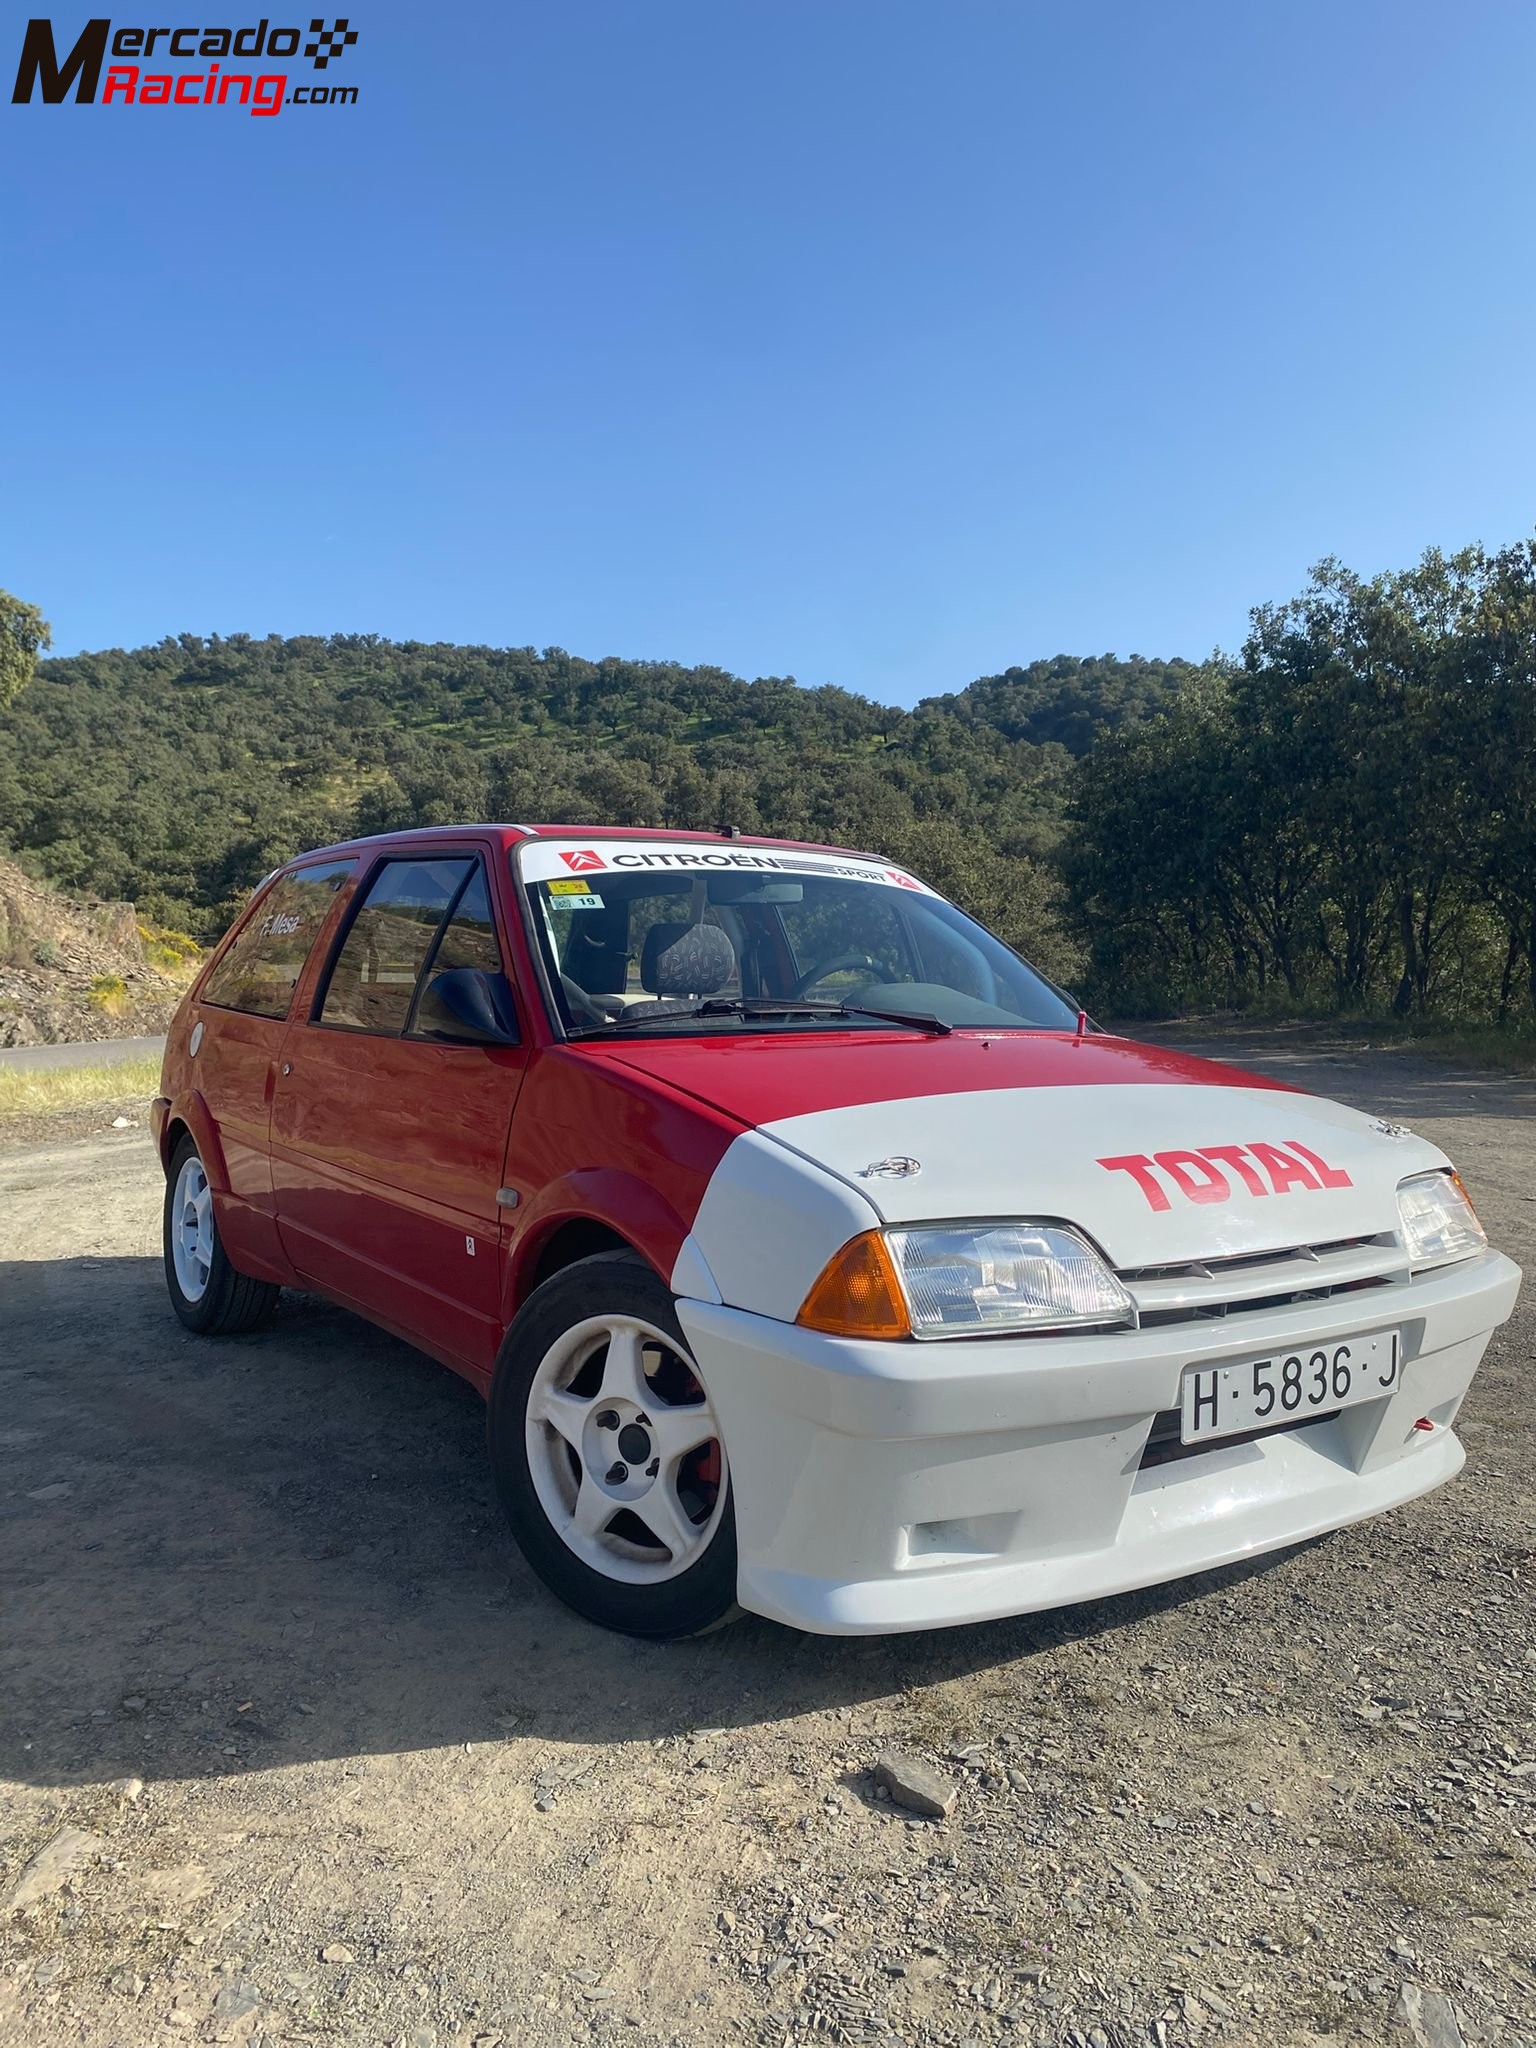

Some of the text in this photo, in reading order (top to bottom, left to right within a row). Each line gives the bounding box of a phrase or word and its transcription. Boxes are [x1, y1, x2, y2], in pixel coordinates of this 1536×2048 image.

[612, 853, 886, 882] CITROËN SPORT
[579, 897, 596, 906] 19
[1096, 1141, 1354, 1212] TOTAL
